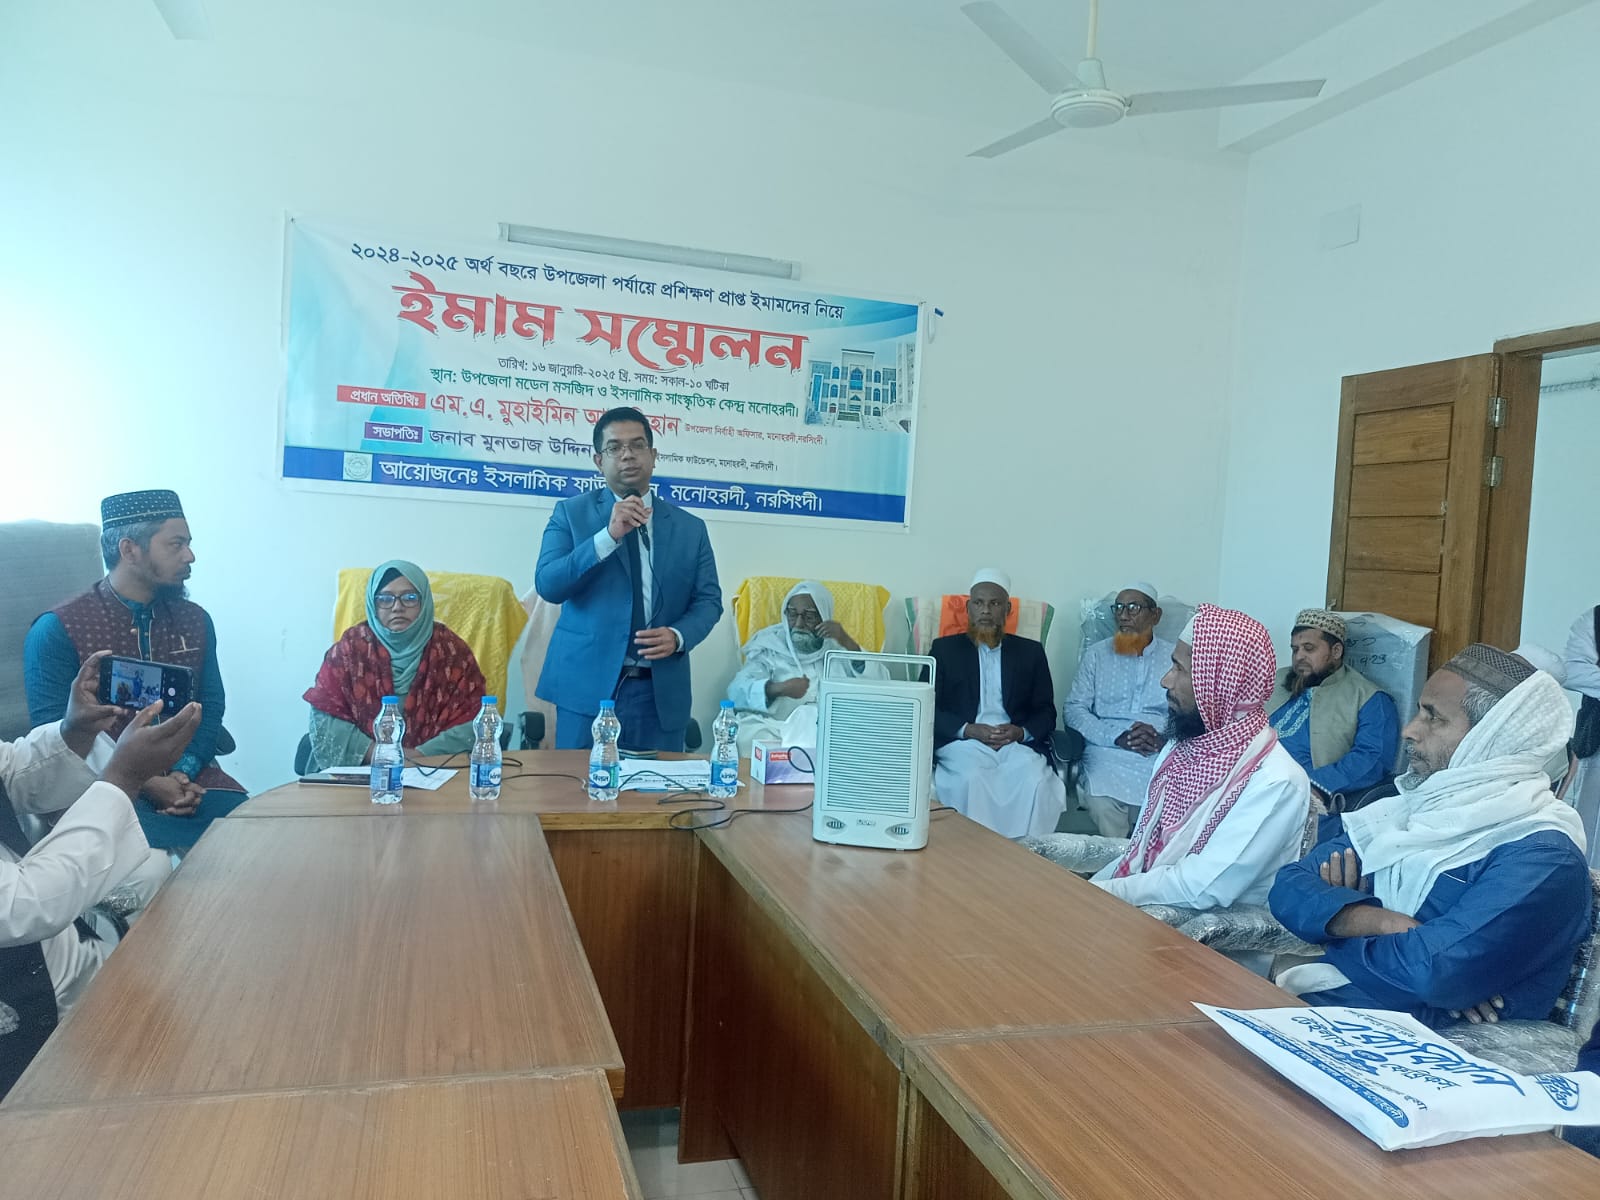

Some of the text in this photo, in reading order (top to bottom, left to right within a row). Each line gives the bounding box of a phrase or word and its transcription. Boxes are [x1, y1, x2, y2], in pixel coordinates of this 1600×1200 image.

[351, 242, 845, 320] ২০২৪-২০২৫ অর্থ বছরে উপজেলা পর্যায়ে প্রশিক্ষণ প্রাপ্ত ইমামদের নিয়ে
[391, 269, 809, 374] ইমাম সম্মেলন
[430, 367, 457, 384] স্থান:
[461, 368, 511, 390] উপজেলা
[515, 374, 549, 393] মডেল
[552, 378, 595, 398] মসজিদ
[597, 387, 608, 397] ও
[610, 383, 663, 404] ইসলামিক
[665, 391, 716, 412] সাংস্কৃতিক
[718, 398, 746, 415] কেন্দ্র
[531, 362, 546, 373] ১৬
[704, 378, 730, 393] ঘটিকা
[350, 390, 378, 403] প্রধান
[499, 397, 577, 426] মুহাইমিন
[429, 428, 476, 447] জনাব
[482, 432, 543, 454] মুনতাজ
[547, 436, 593, 458] উদ্দিন
[482, 464, 568, 491] ইসলামিক
[670, 483, 751, 510] মনোহরদী,
[756, 489, 824, 513] নরসিংদী।
